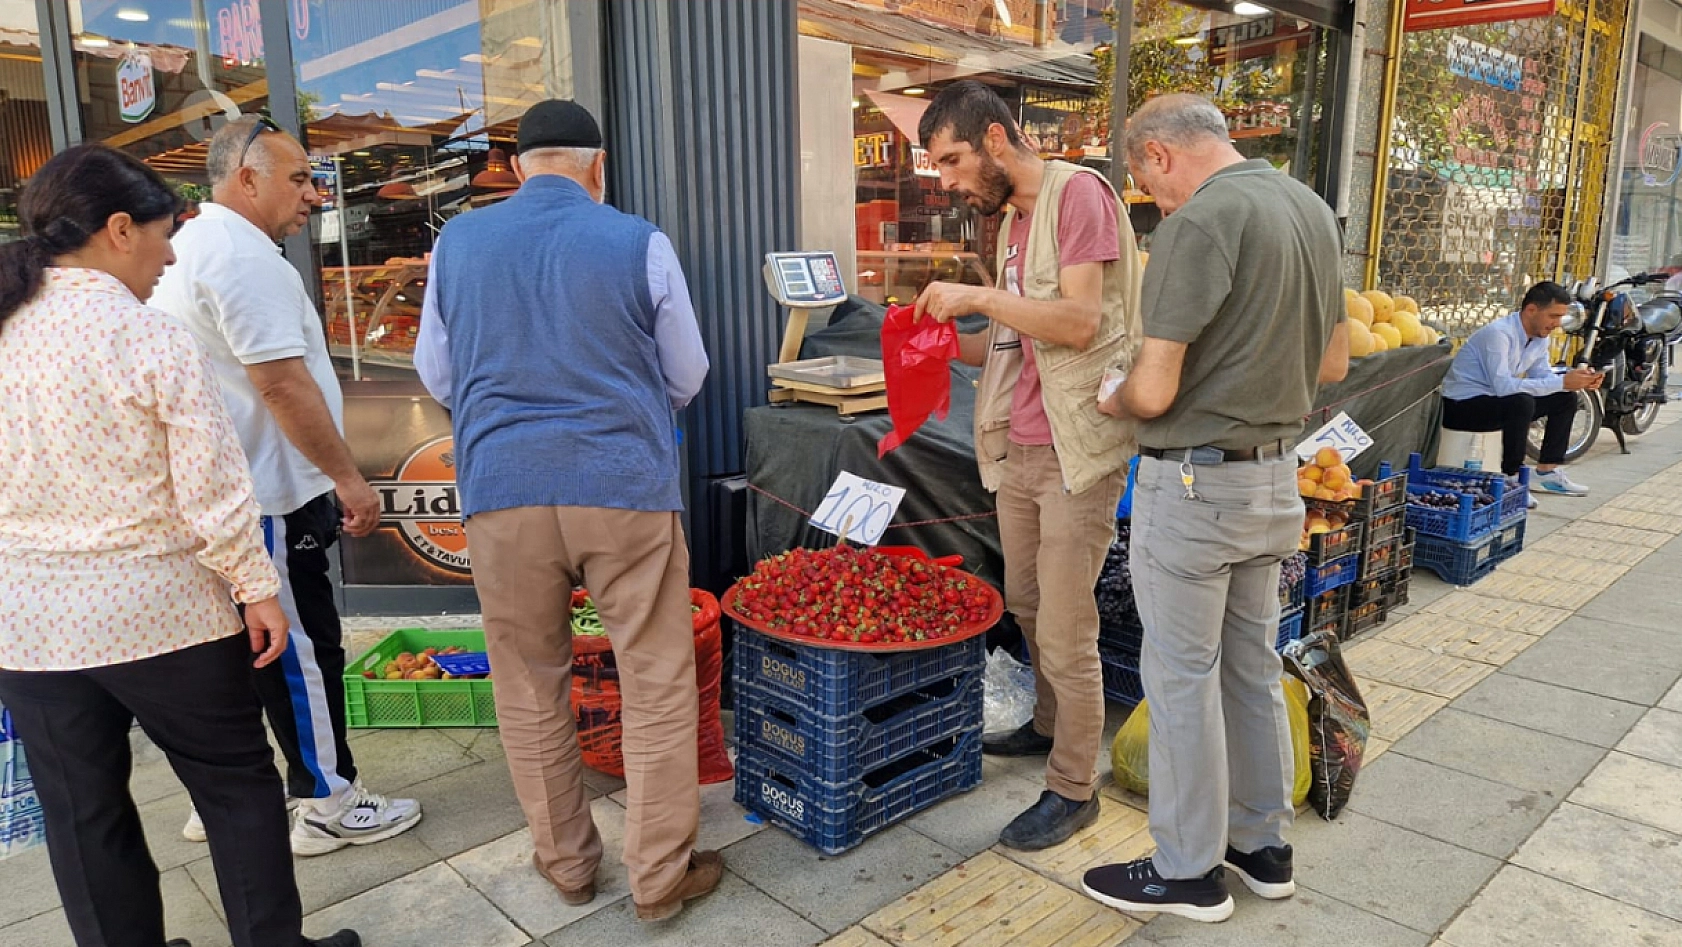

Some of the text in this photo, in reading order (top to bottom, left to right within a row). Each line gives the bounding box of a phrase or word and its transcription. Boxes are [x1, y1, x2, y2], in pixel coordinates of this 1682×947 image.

[120, 66, 153, 108] Banvit
[808, 487, 891, 543] 100
[413, 535, 428, 549] ET
[426, 545, 436, 555] &
[762, 656, 806, 683] DOGUS
[762, 720, 805, 749] DOGUS
[762, 783, 805, 814] DOGUS
